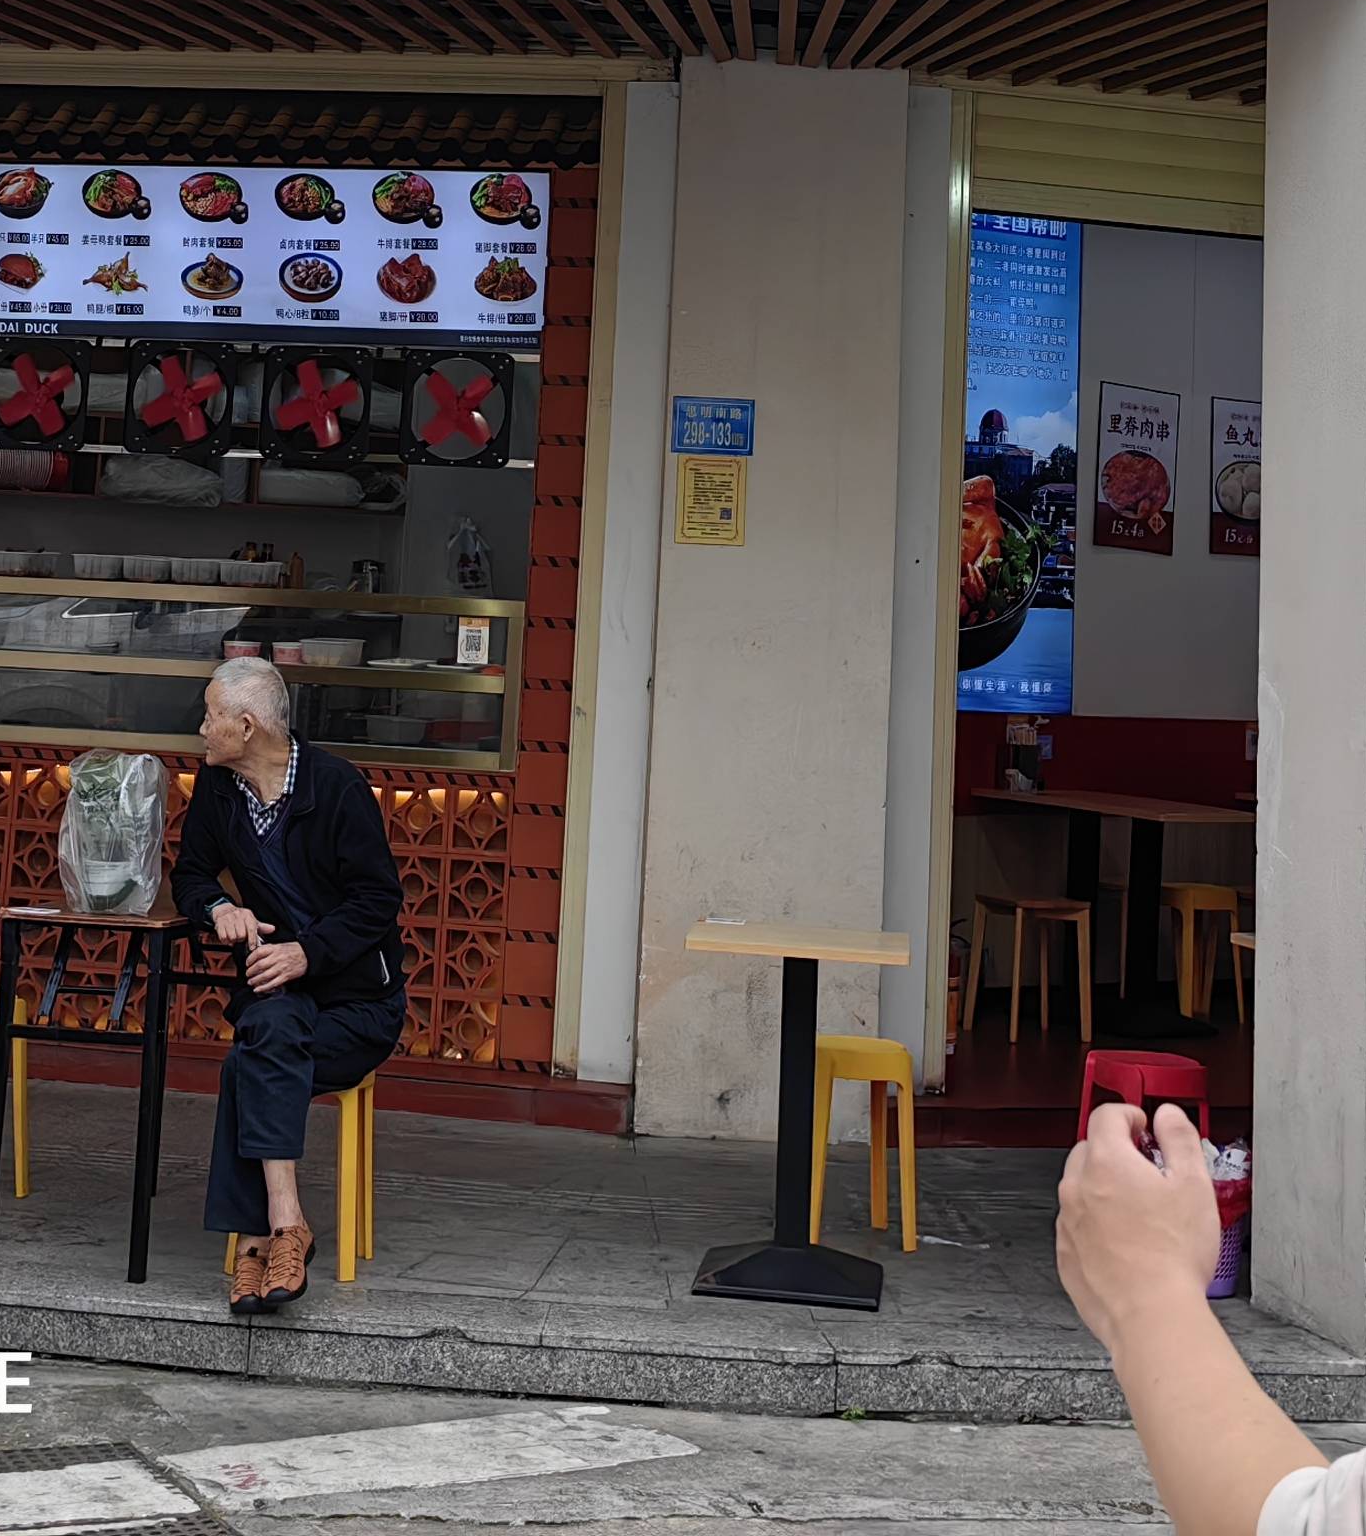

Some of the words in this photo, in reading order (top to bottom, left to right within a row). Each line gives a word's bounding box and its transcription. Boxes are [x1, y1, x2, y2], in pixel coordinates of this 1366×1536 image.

[25, 323, 58, 334] DUCK
[1107, 414, 1171, 441] 里脊肉串
[1224, 424, 1261, 448] 鱼丸
